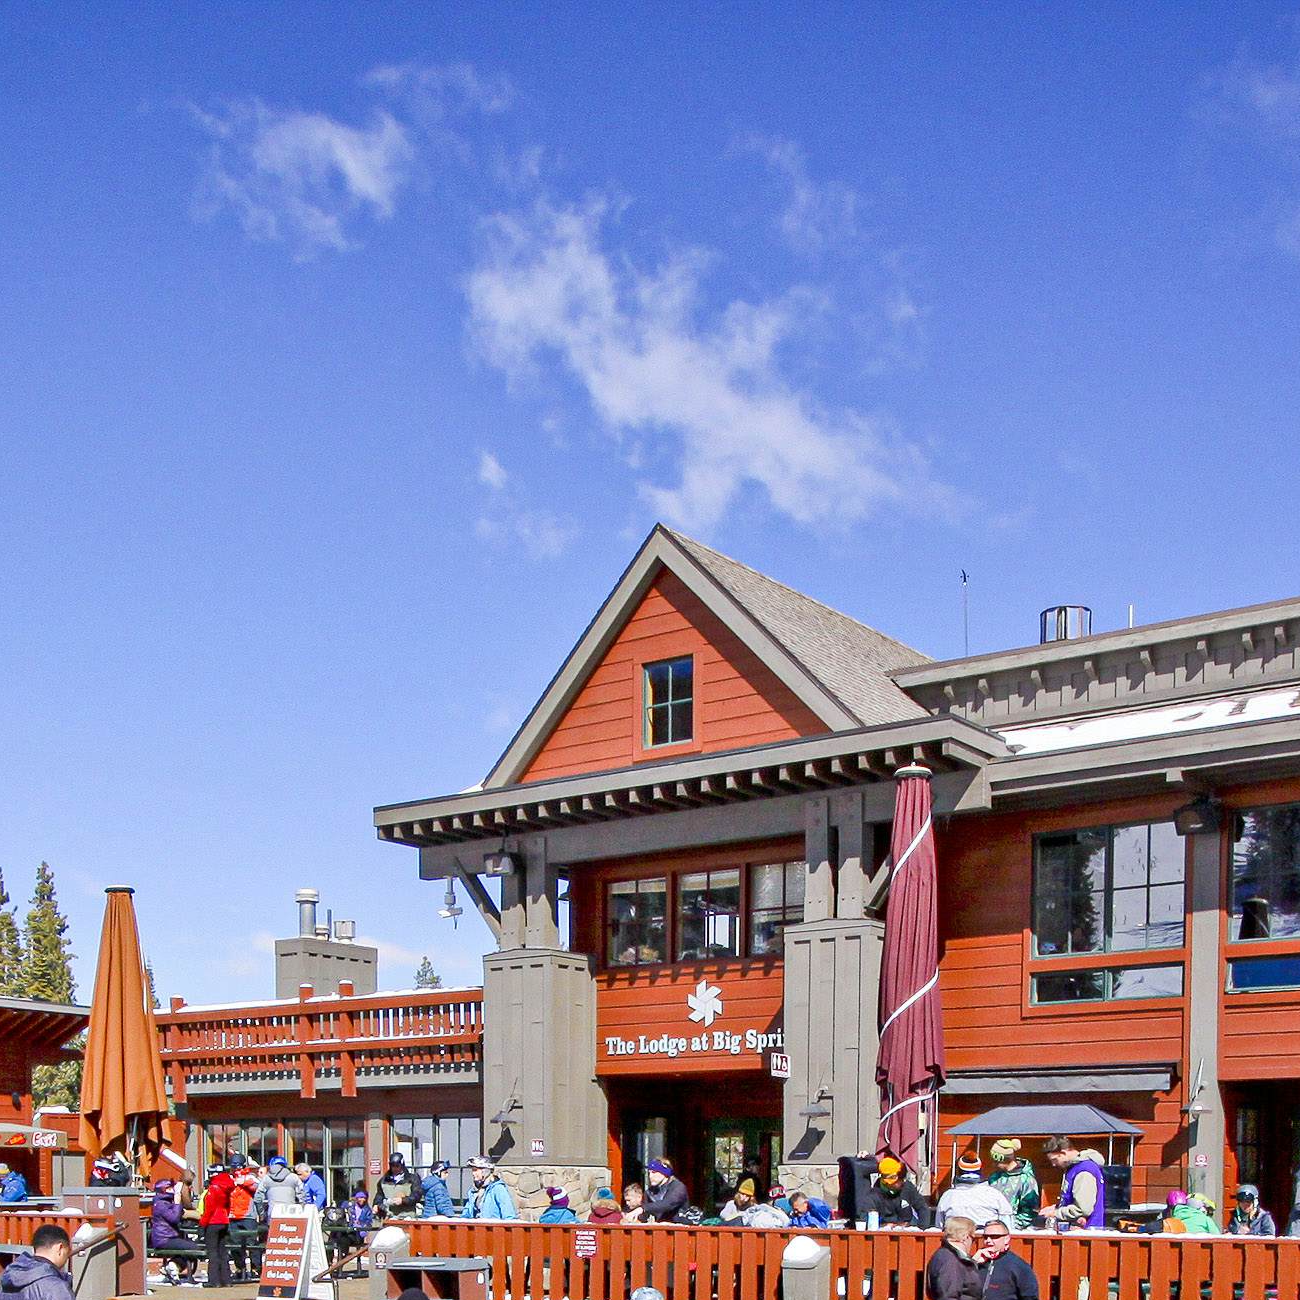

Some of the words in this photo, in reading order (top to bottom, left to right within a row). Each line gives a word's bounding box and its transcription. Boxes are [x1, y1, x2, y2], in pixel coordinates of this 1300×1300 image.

[605, 1037, 635, 1055] The
[639, 1034, 687, 1057] Lodge
[691, 1033, 709, 1050] at
[712, 1031, 741, 1055] Big
[746, 1027, 785, 1053] Spri
